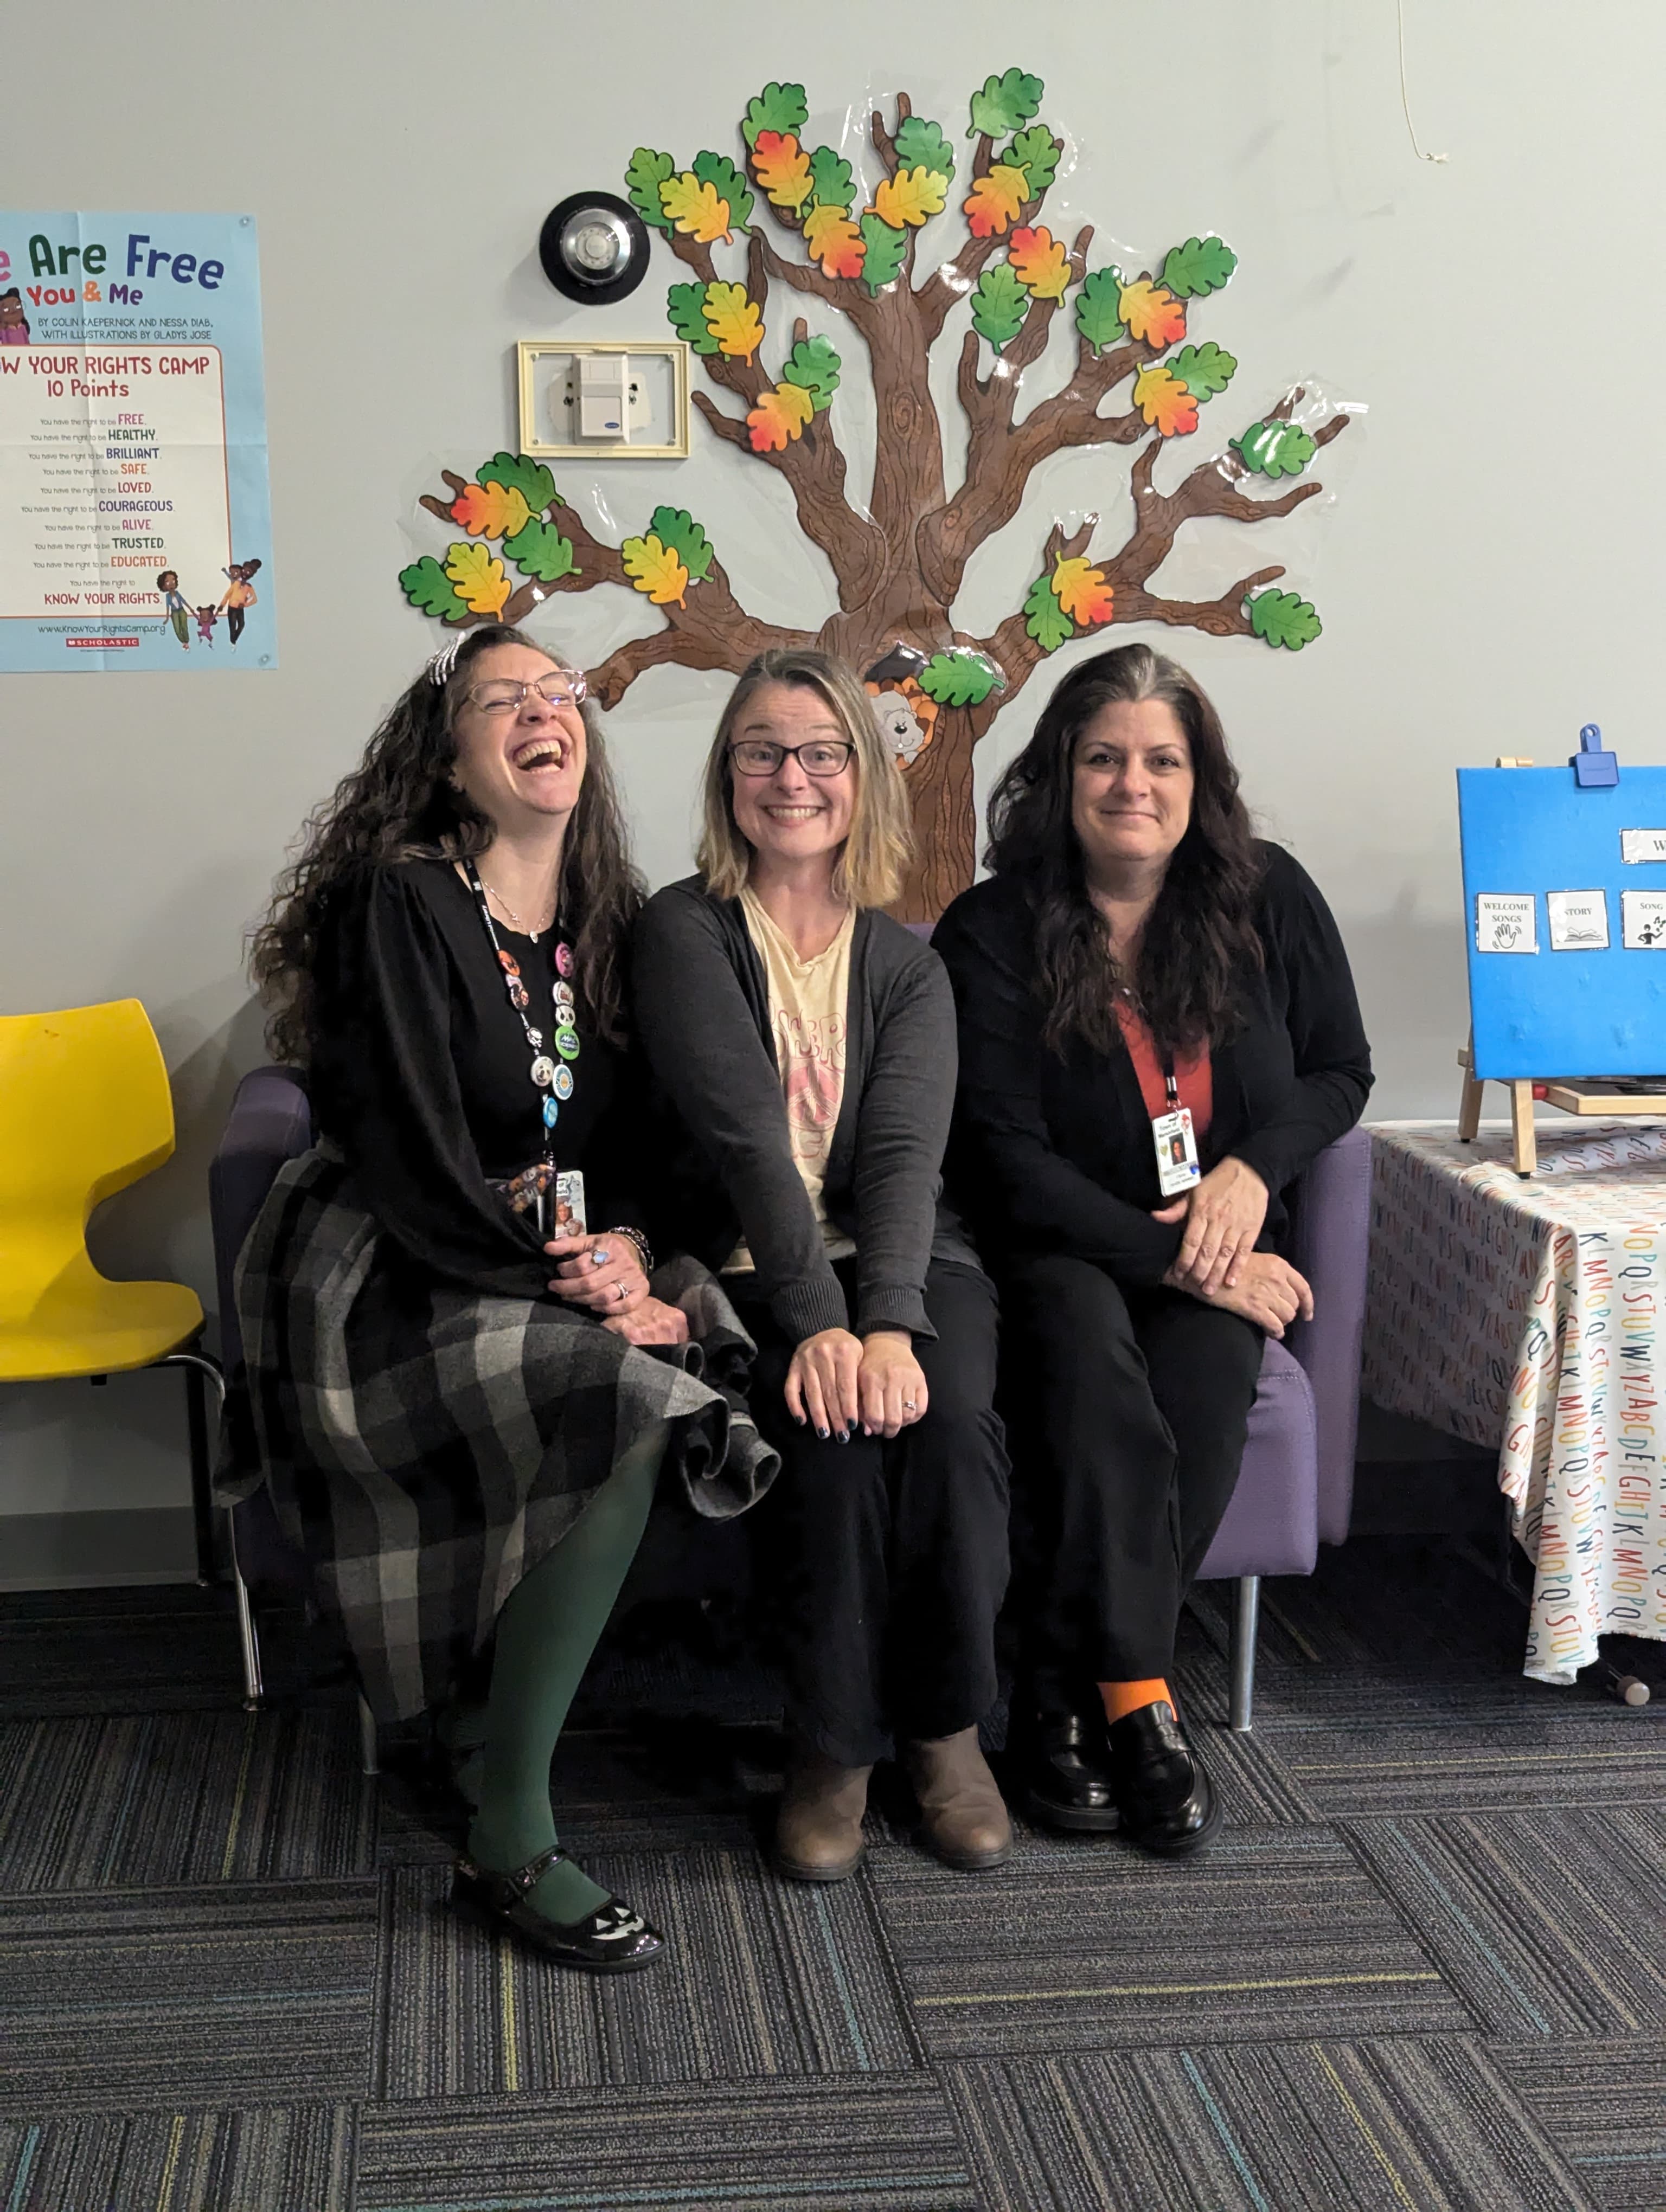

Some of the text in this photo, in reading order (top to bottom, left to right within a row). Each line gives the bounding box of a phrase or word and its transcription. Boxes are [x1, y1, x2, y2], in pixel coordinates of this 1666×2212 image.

[0, 234, 225, 290] e Are Free
[27, 281, 143, 306] You & Me
[38, 318, 48, 327] BY
[52, 318, 79, 327] COLIN
[82, 318, 135, 327] KAEPERNICK
[139, 318, 157, 327] AND
[160, 318, 189, 327] NESSA
[41, 331, 212, 339] WITH ILLUSTRATIONS BY GLADYS JOSE
[29, 357, 78, 375] YOUR
[85, 357, 152, 375] RIGHTS
[159, 357, 209, 374] CAMP
[48, 379, 129, 397] 10 Points
[82, 419, 97, 428] right
[73, 434, 87, 443] right
[71, 453, 86, 462] right
[85, 468, 100, 478] right
[83, 487, 98, 497] right
[63, 506, 78, 515] right
[87, 525, 102, 534] right
[76, 543, 91, 552] right
[76, 562, 90, 571] right
[112, 580, 127, 589] right
[44, 593, 80, 605] KNOW
[85, 593, 115, 605] YOUR
[39, 625, 166, 635] www.KnowYourRightsCamp.org
[1484, 903, 1529, 911] WELCOME
[1640, 902, 1663, 910] SONG
